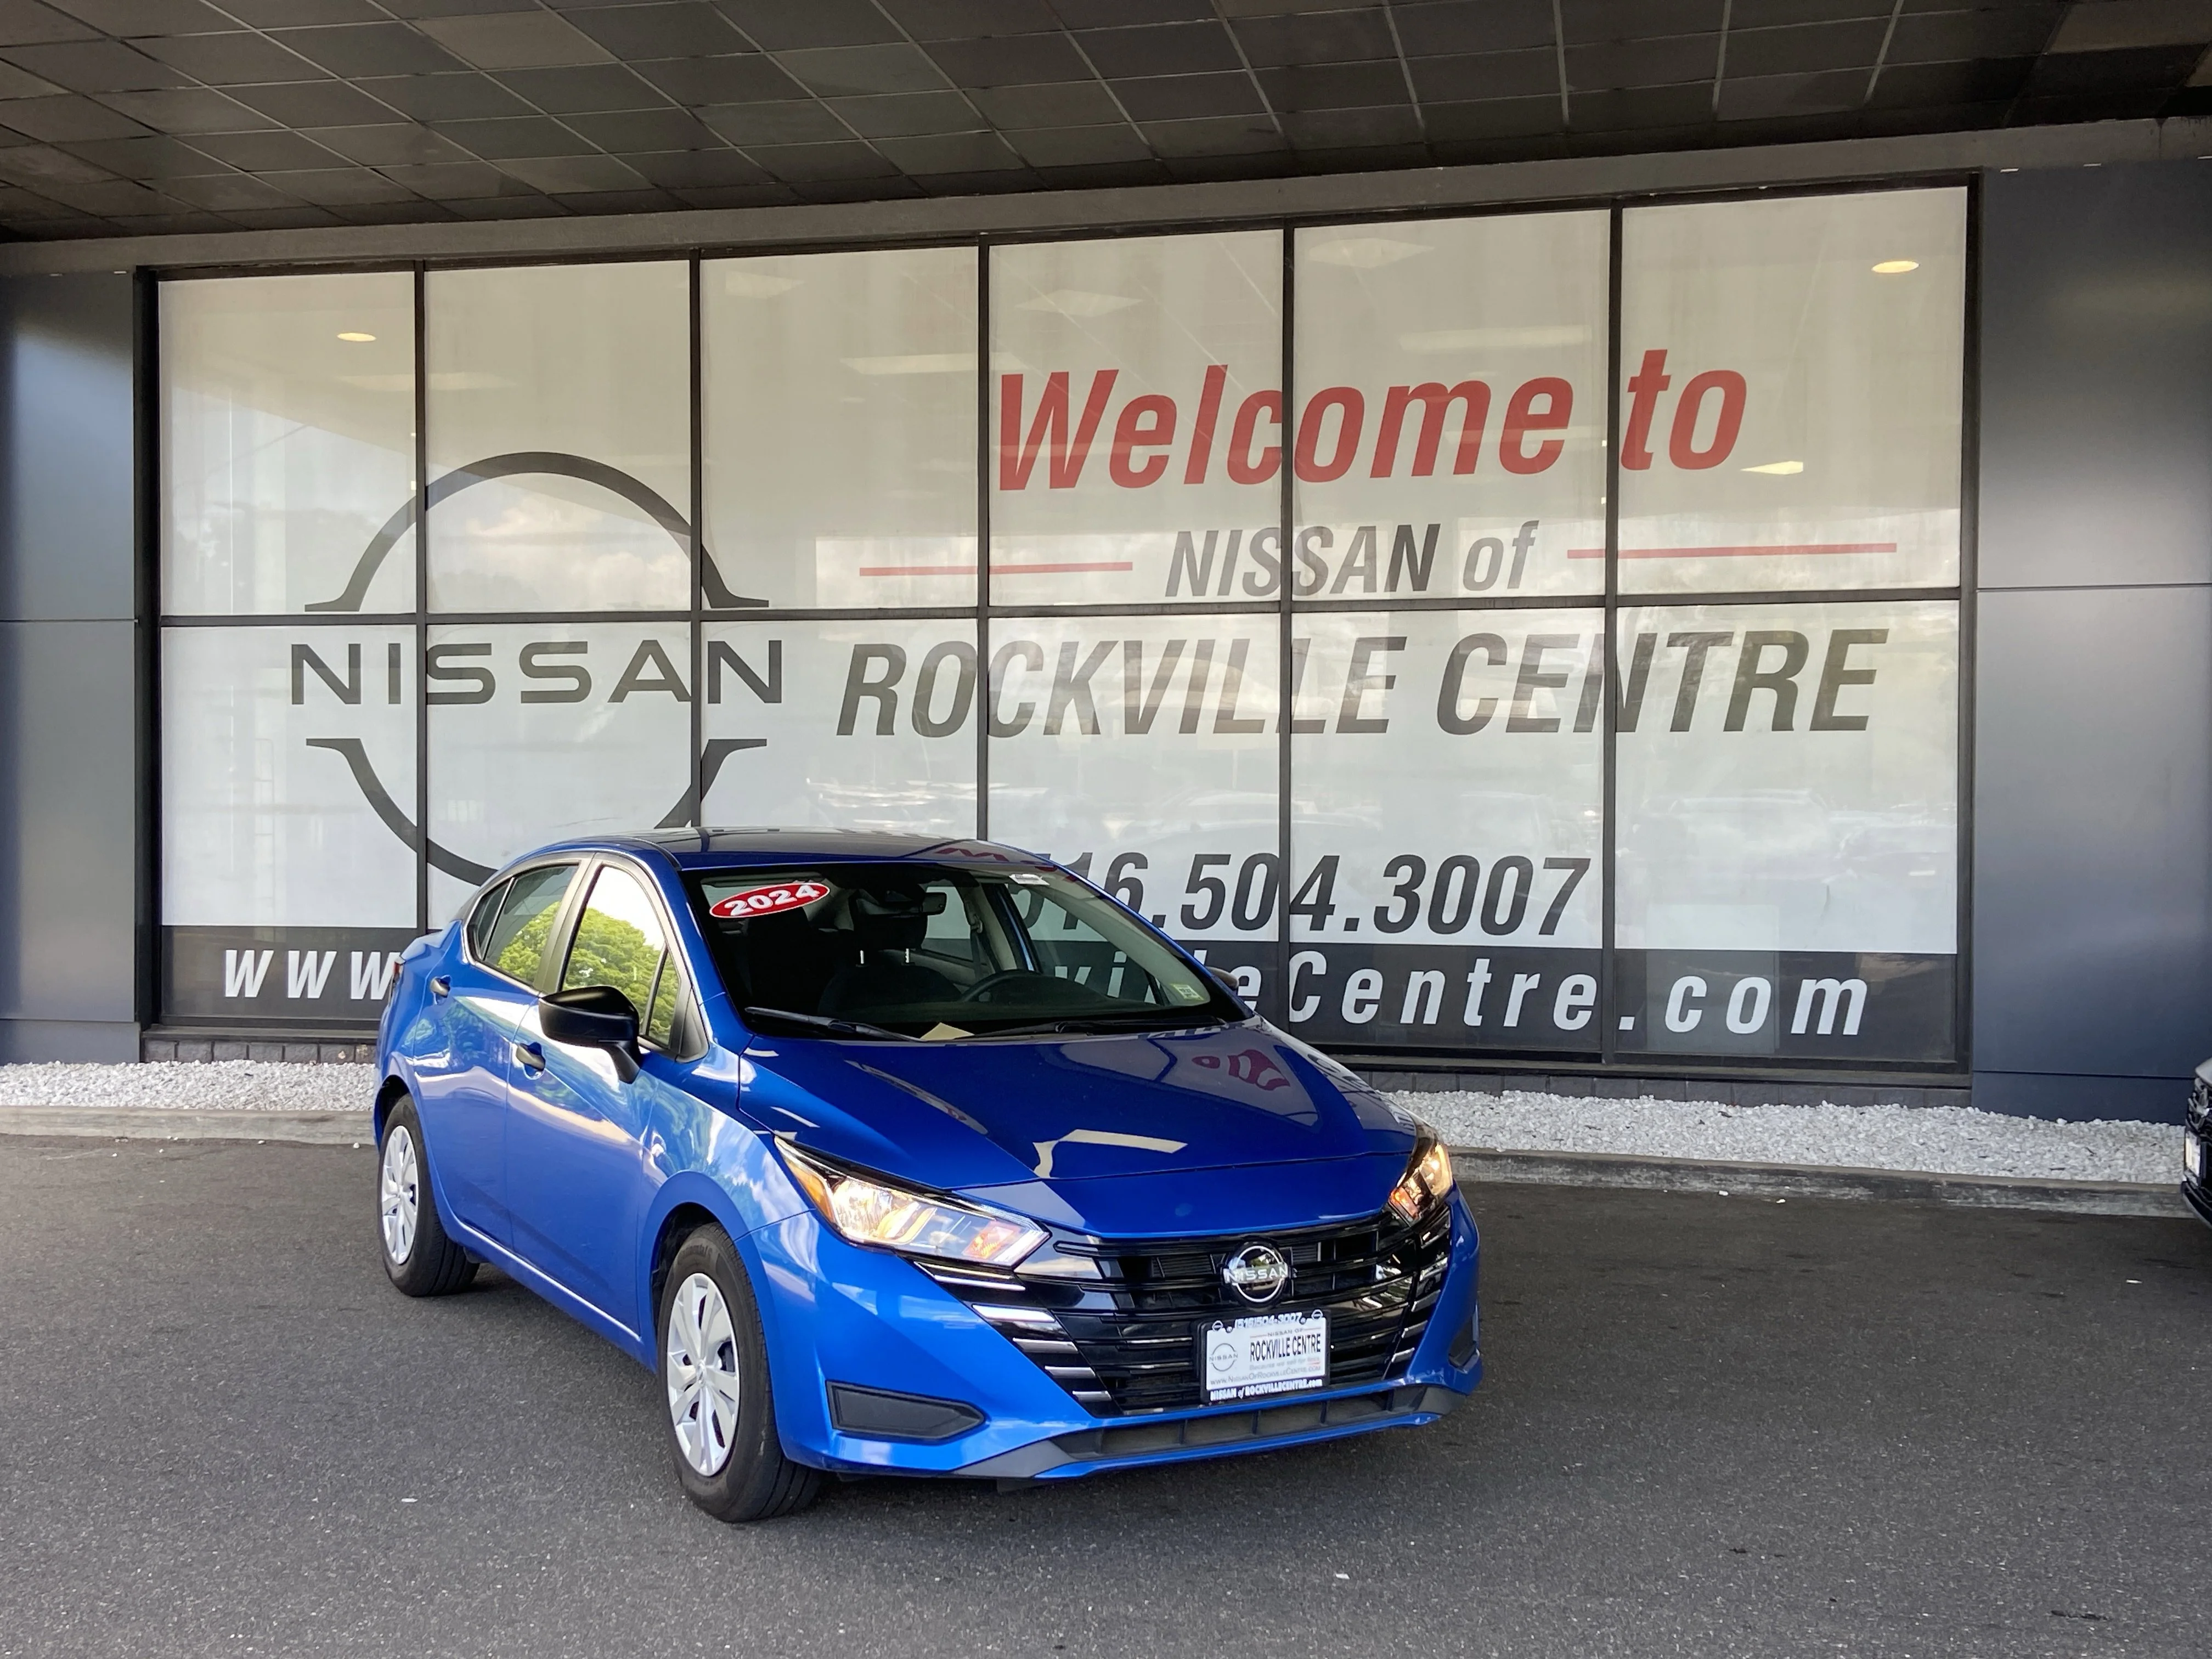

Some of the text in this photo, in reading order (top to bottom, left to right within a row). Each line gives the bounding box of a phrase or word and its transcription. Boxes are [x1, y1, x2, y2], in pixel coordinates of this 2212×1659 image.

[999, 349, 1747, 490] Welcome to
[1165, 520, 1539, 597] NISSAN of
[291, 640, 782, 705] NISSAN
[836, 628, 1889, 737] ROCKVILLE CENTRE
[724, 884, 820, 916] 2024
[1223, 1261, 1288, 1284] NISSAN
[1209, 1353, 1238, 1362] NISSAN
[1250, 1333, 1321, 1362] ROCKVILLE CENTRE
[1210, 1388, 1237, 1401] NISSAN
[1238, 1387, 1245, 1400] of
